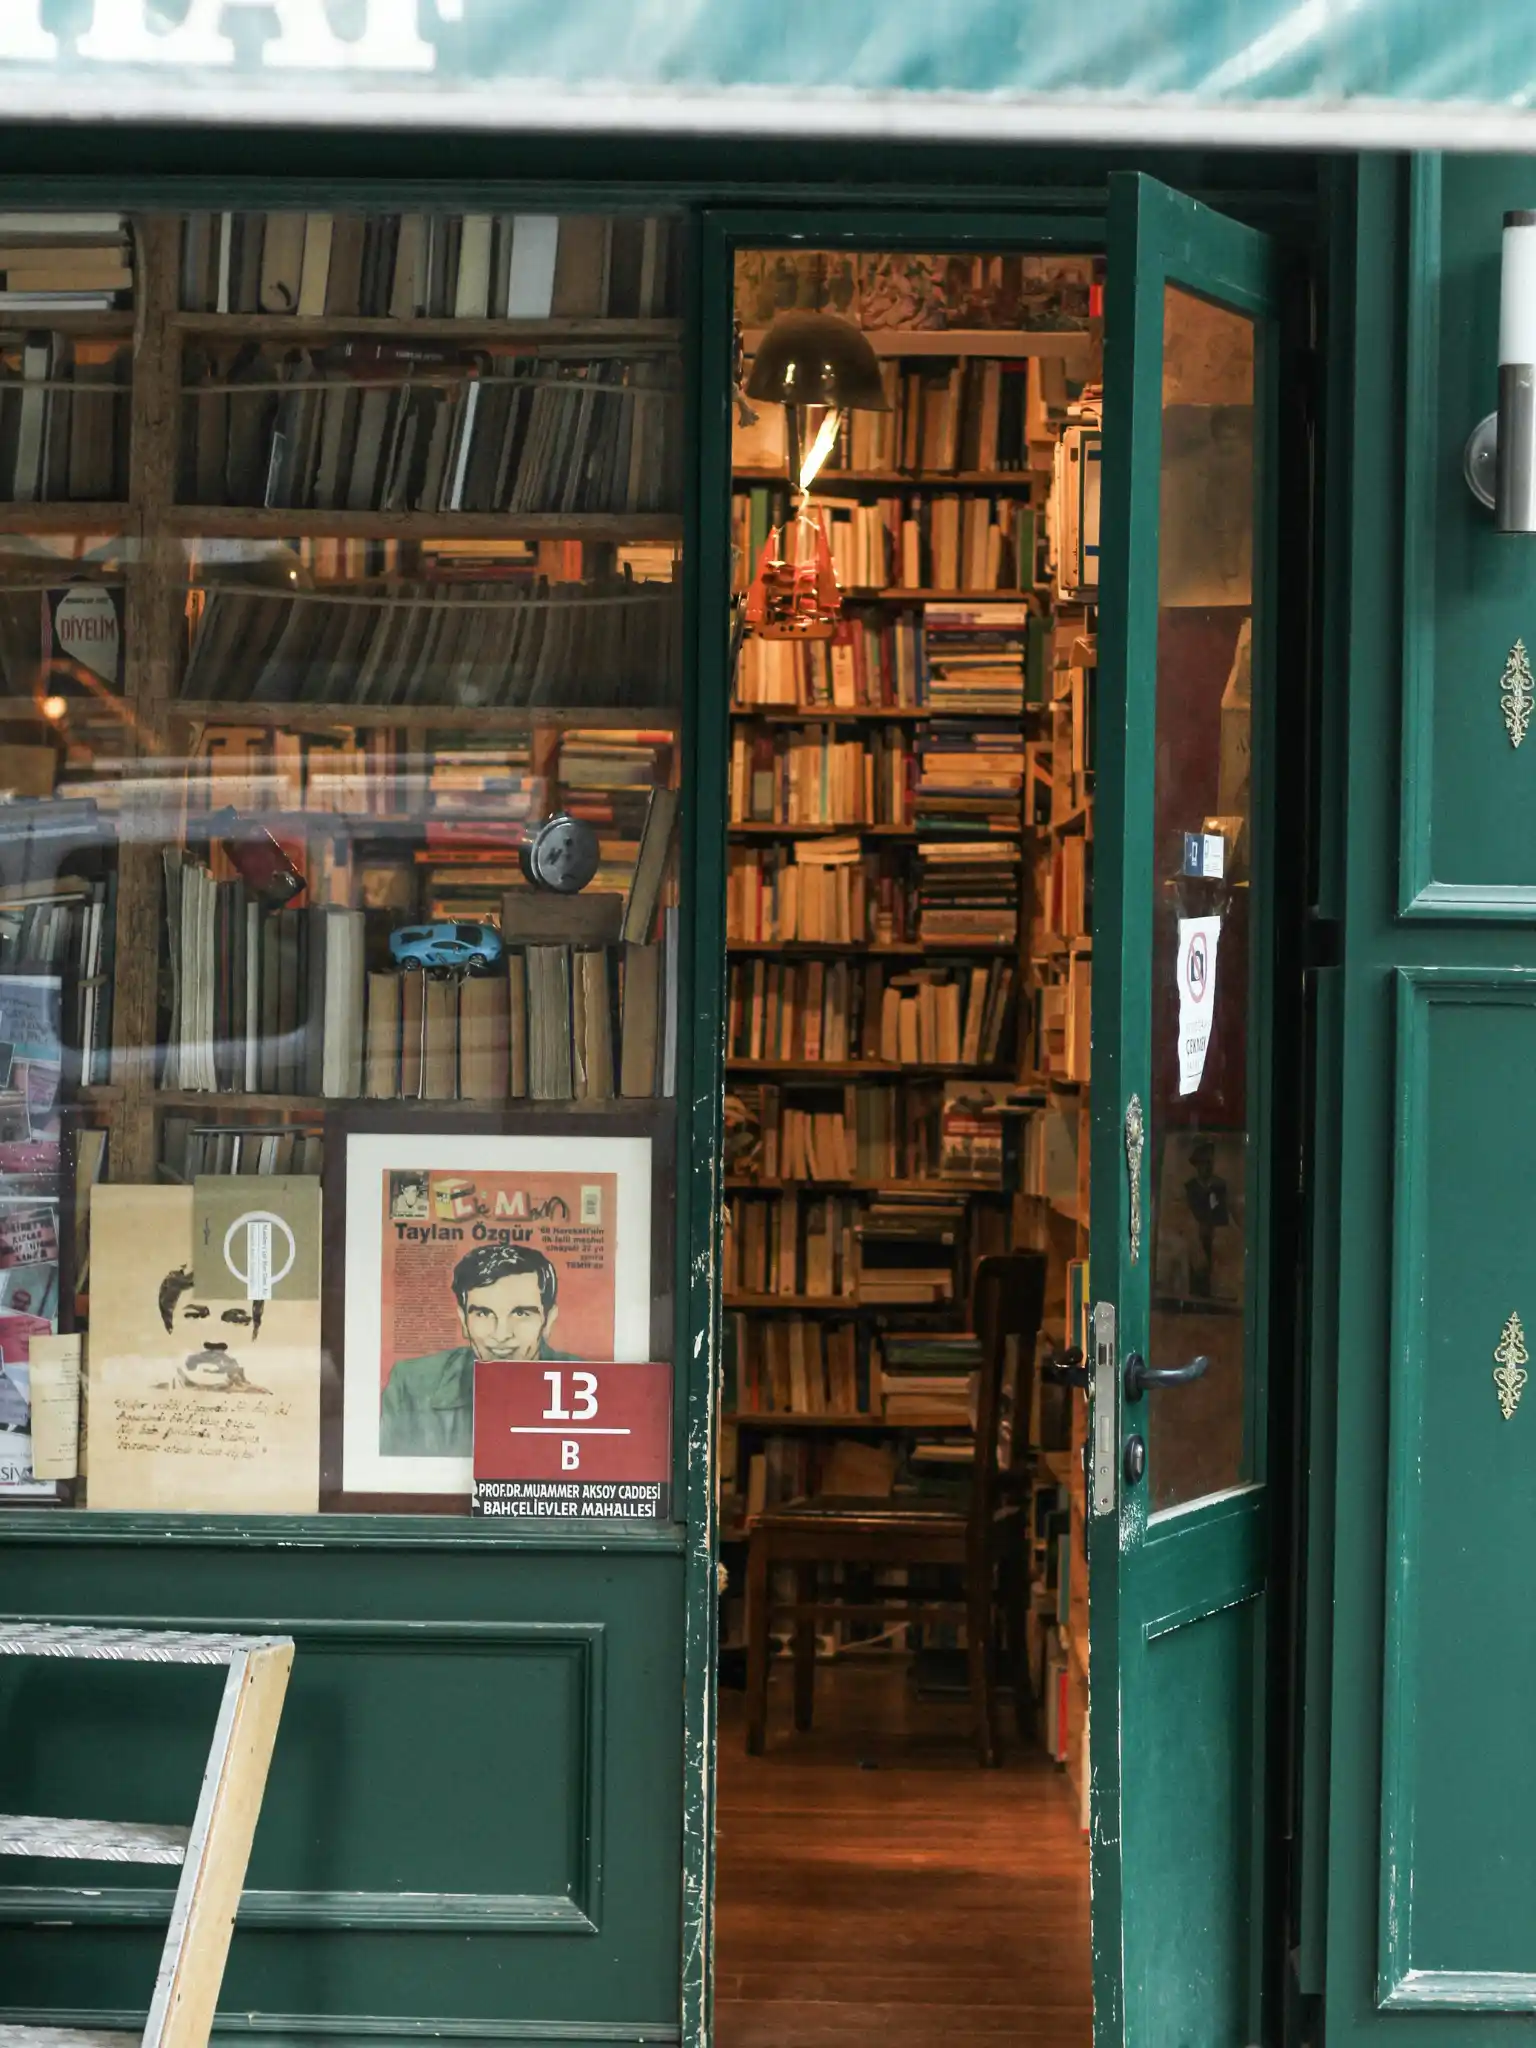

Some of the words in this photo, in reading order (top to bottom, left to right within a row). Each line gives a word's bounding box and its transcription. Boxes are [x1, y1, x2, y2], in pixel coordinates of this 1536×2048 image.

[61, 615, 115, 641] DİYELİM
[394, 1223, 463, 1244] Taylan
[472, 1220, 533, 1245] Özgür
[542, 1371, 599, 1420] 13
[561, 1440, 580, 1471] B
[478, 1483, 580, 1498] PROF.DR.MUAMMER
[582, 1485, 616, 1499] AKSOY
[618, 1483, 661, 1500] CADDESİ
[483, 1499, 578, 1518] BAHÇELİEVLER
[581, 1500, 656, 1517] MAHALLESİ
